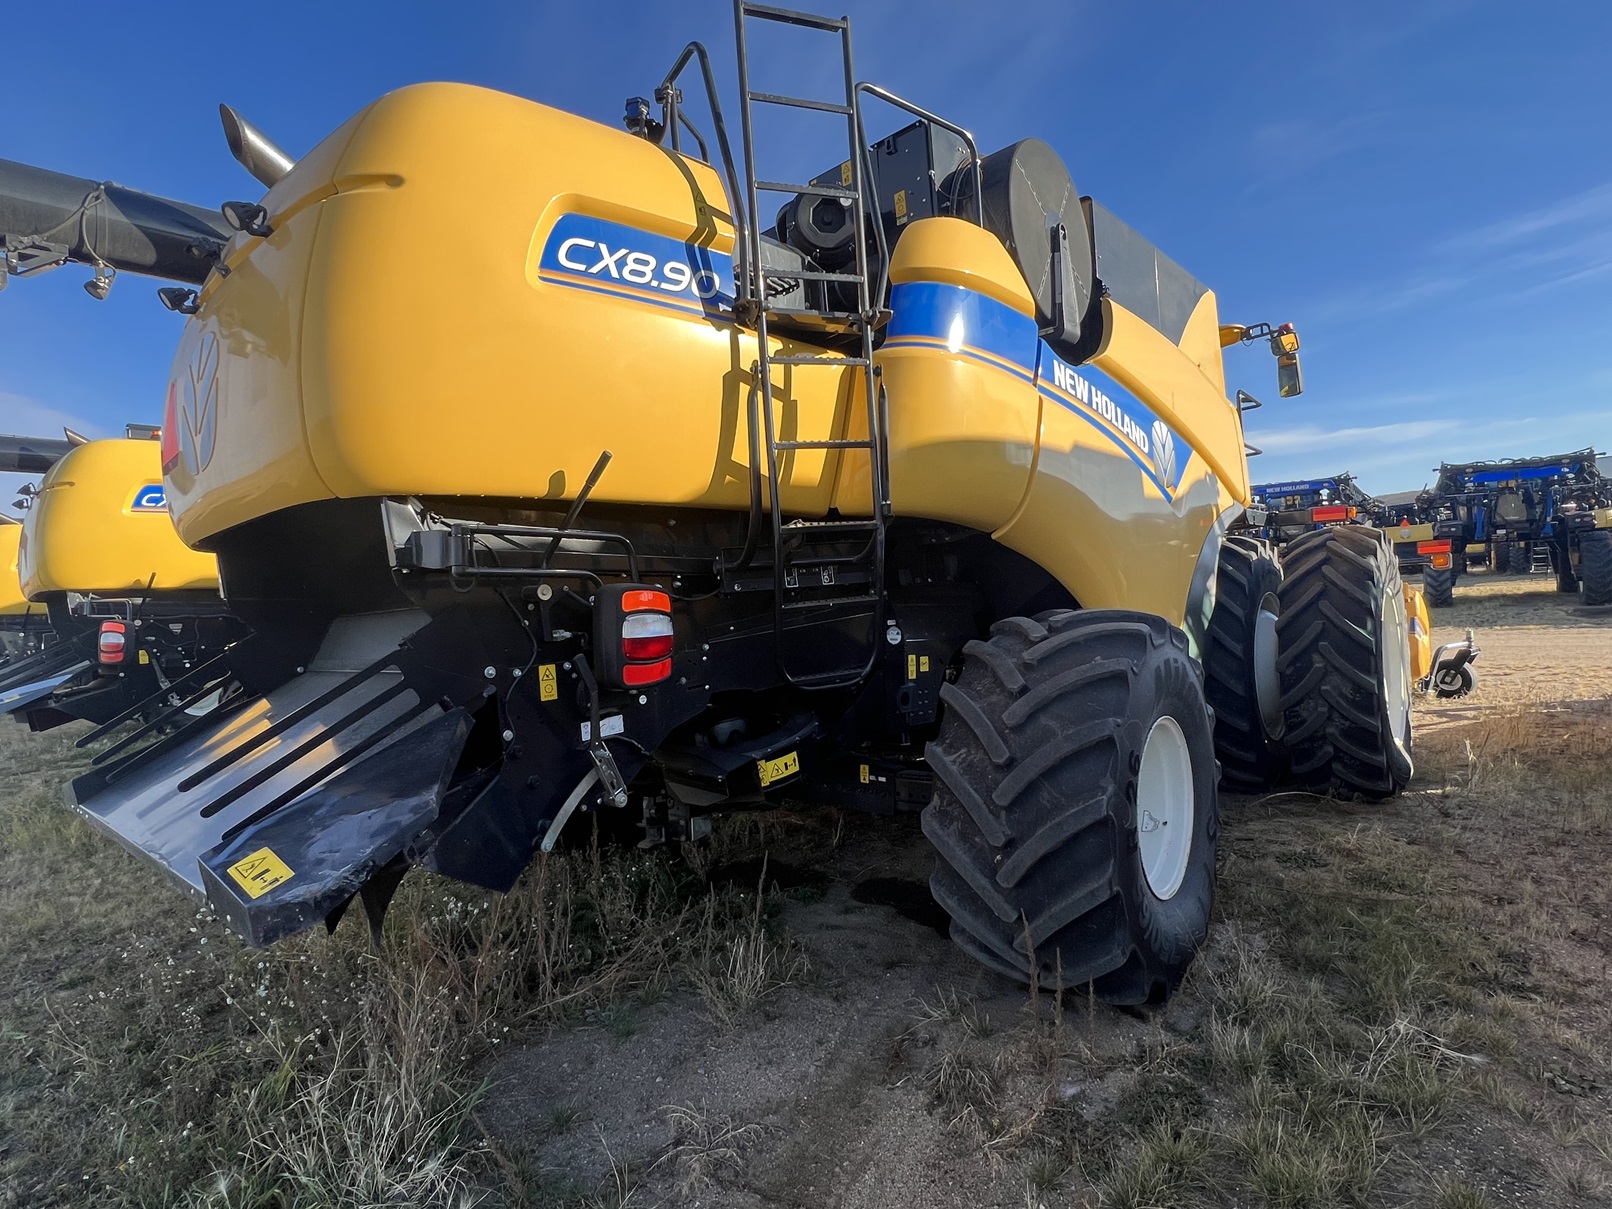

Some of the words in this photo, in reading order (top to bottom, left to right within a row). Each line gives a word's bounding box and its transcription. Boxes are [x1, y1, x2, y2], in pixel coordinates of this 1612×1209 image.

[558, 237, 720, 299] CX8.90
[1053, 360, 1089, 404] NEW
[1091, 385, 1149, 454] HOLLAND
[1281, 483, 1310, 492] HOLLAND
